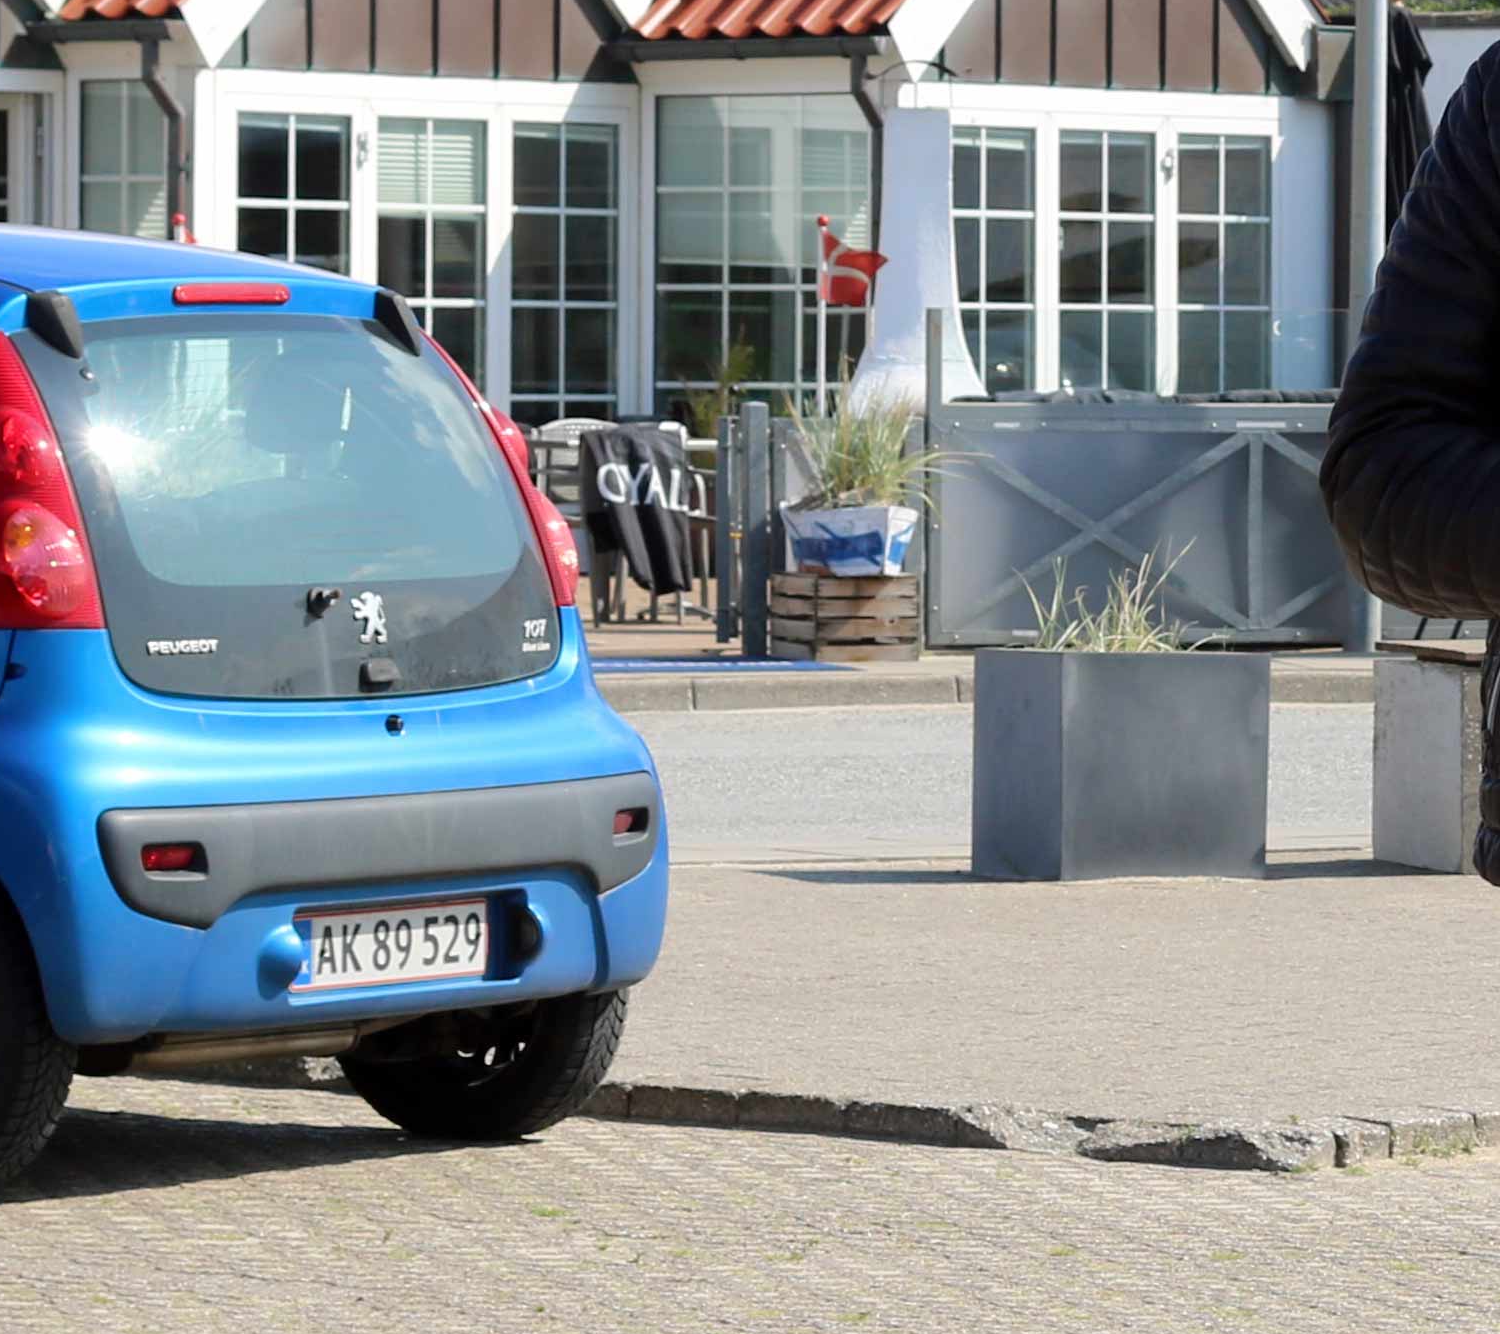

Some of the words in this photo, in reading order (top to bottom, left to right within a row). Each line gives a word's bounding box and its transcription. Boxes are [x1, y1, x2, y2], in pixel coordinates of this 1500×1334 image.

[523, 618, 547, 638] 107
[147, 639, 219, 654] PEUGEOT
[316, 924, 362, 975] AK
[372, 919, 412, 971] 89
[422, 912, 481, 966] 529
